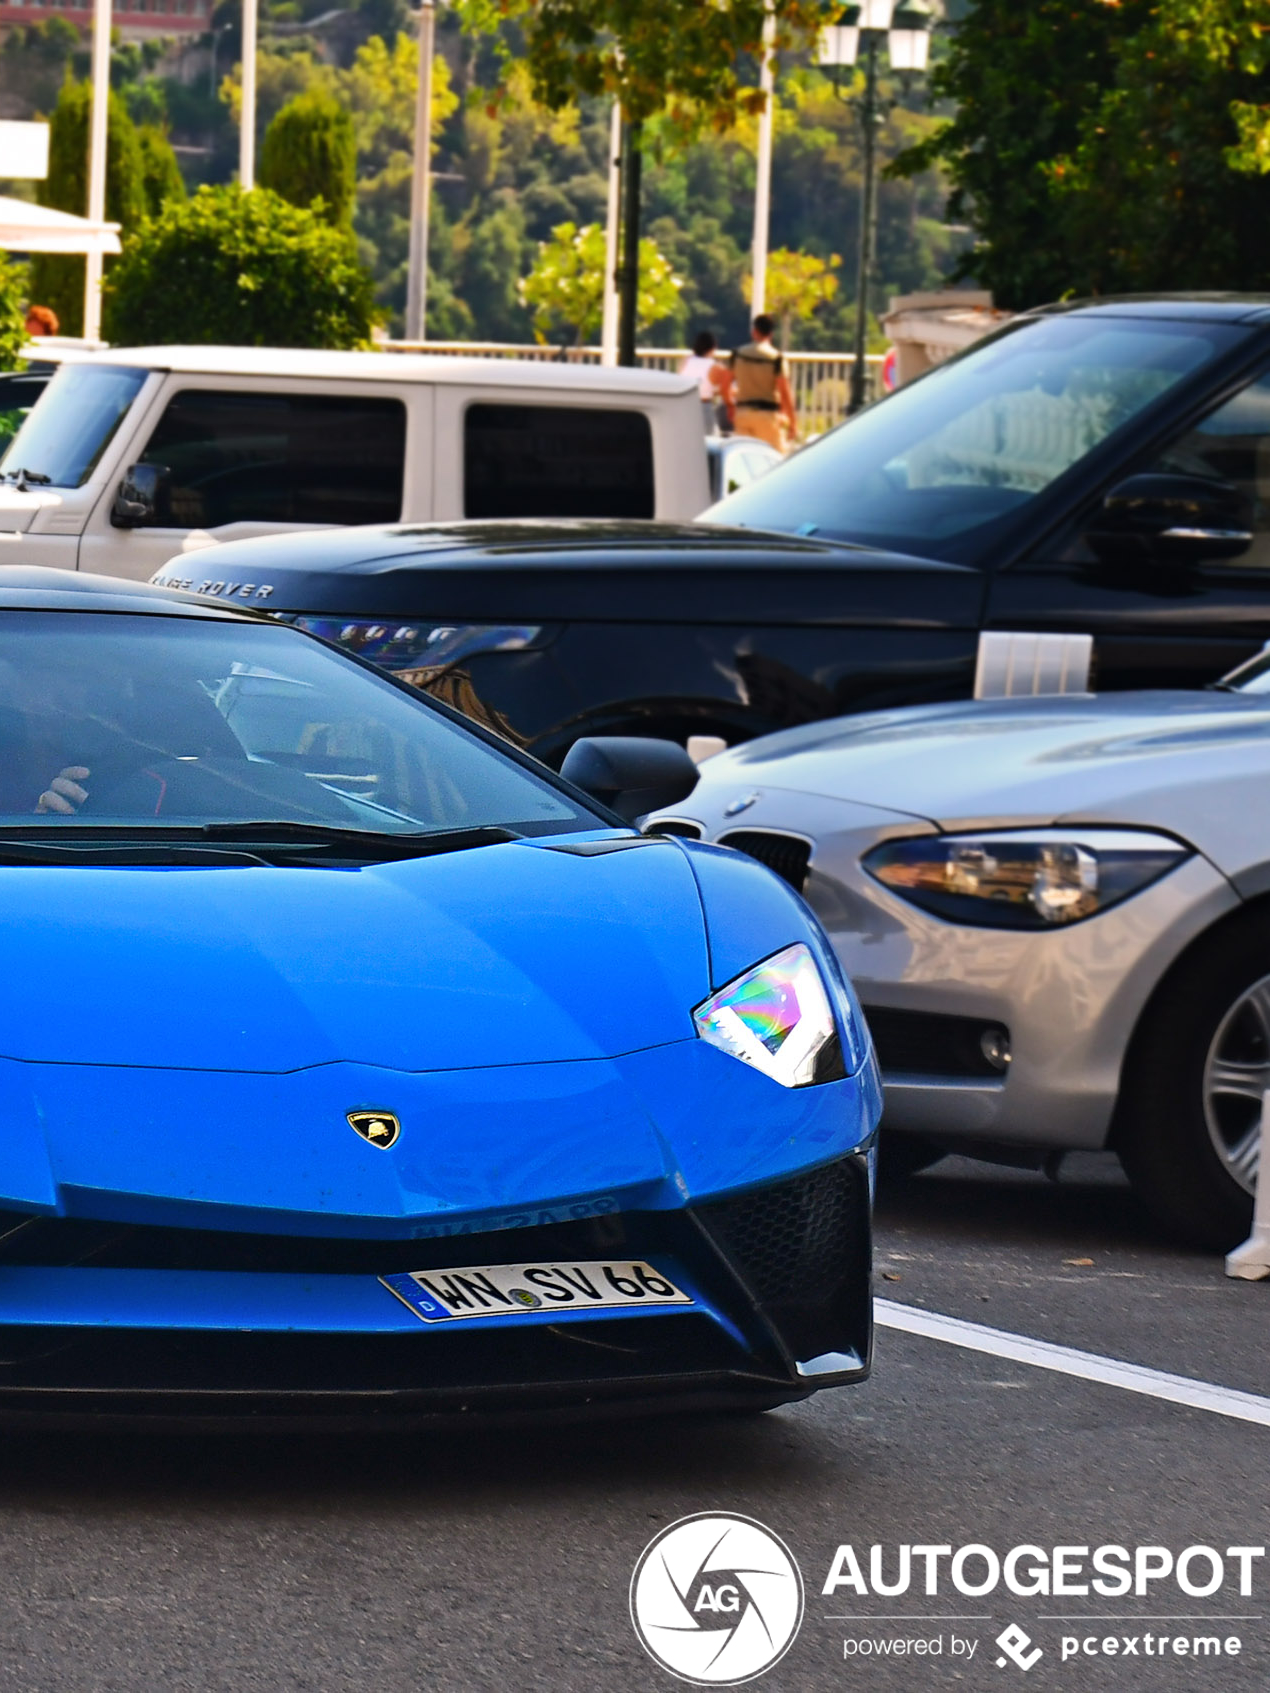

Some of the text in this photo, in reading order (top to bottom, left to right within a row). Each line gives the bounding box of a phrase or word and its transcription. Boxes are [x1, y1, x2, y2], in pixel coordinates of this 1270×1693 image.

[196, 579, 275, 599] ROVER
[418, 1265, 675, 1310] WN SV 66
[417, 1300, 435, 1312] D
